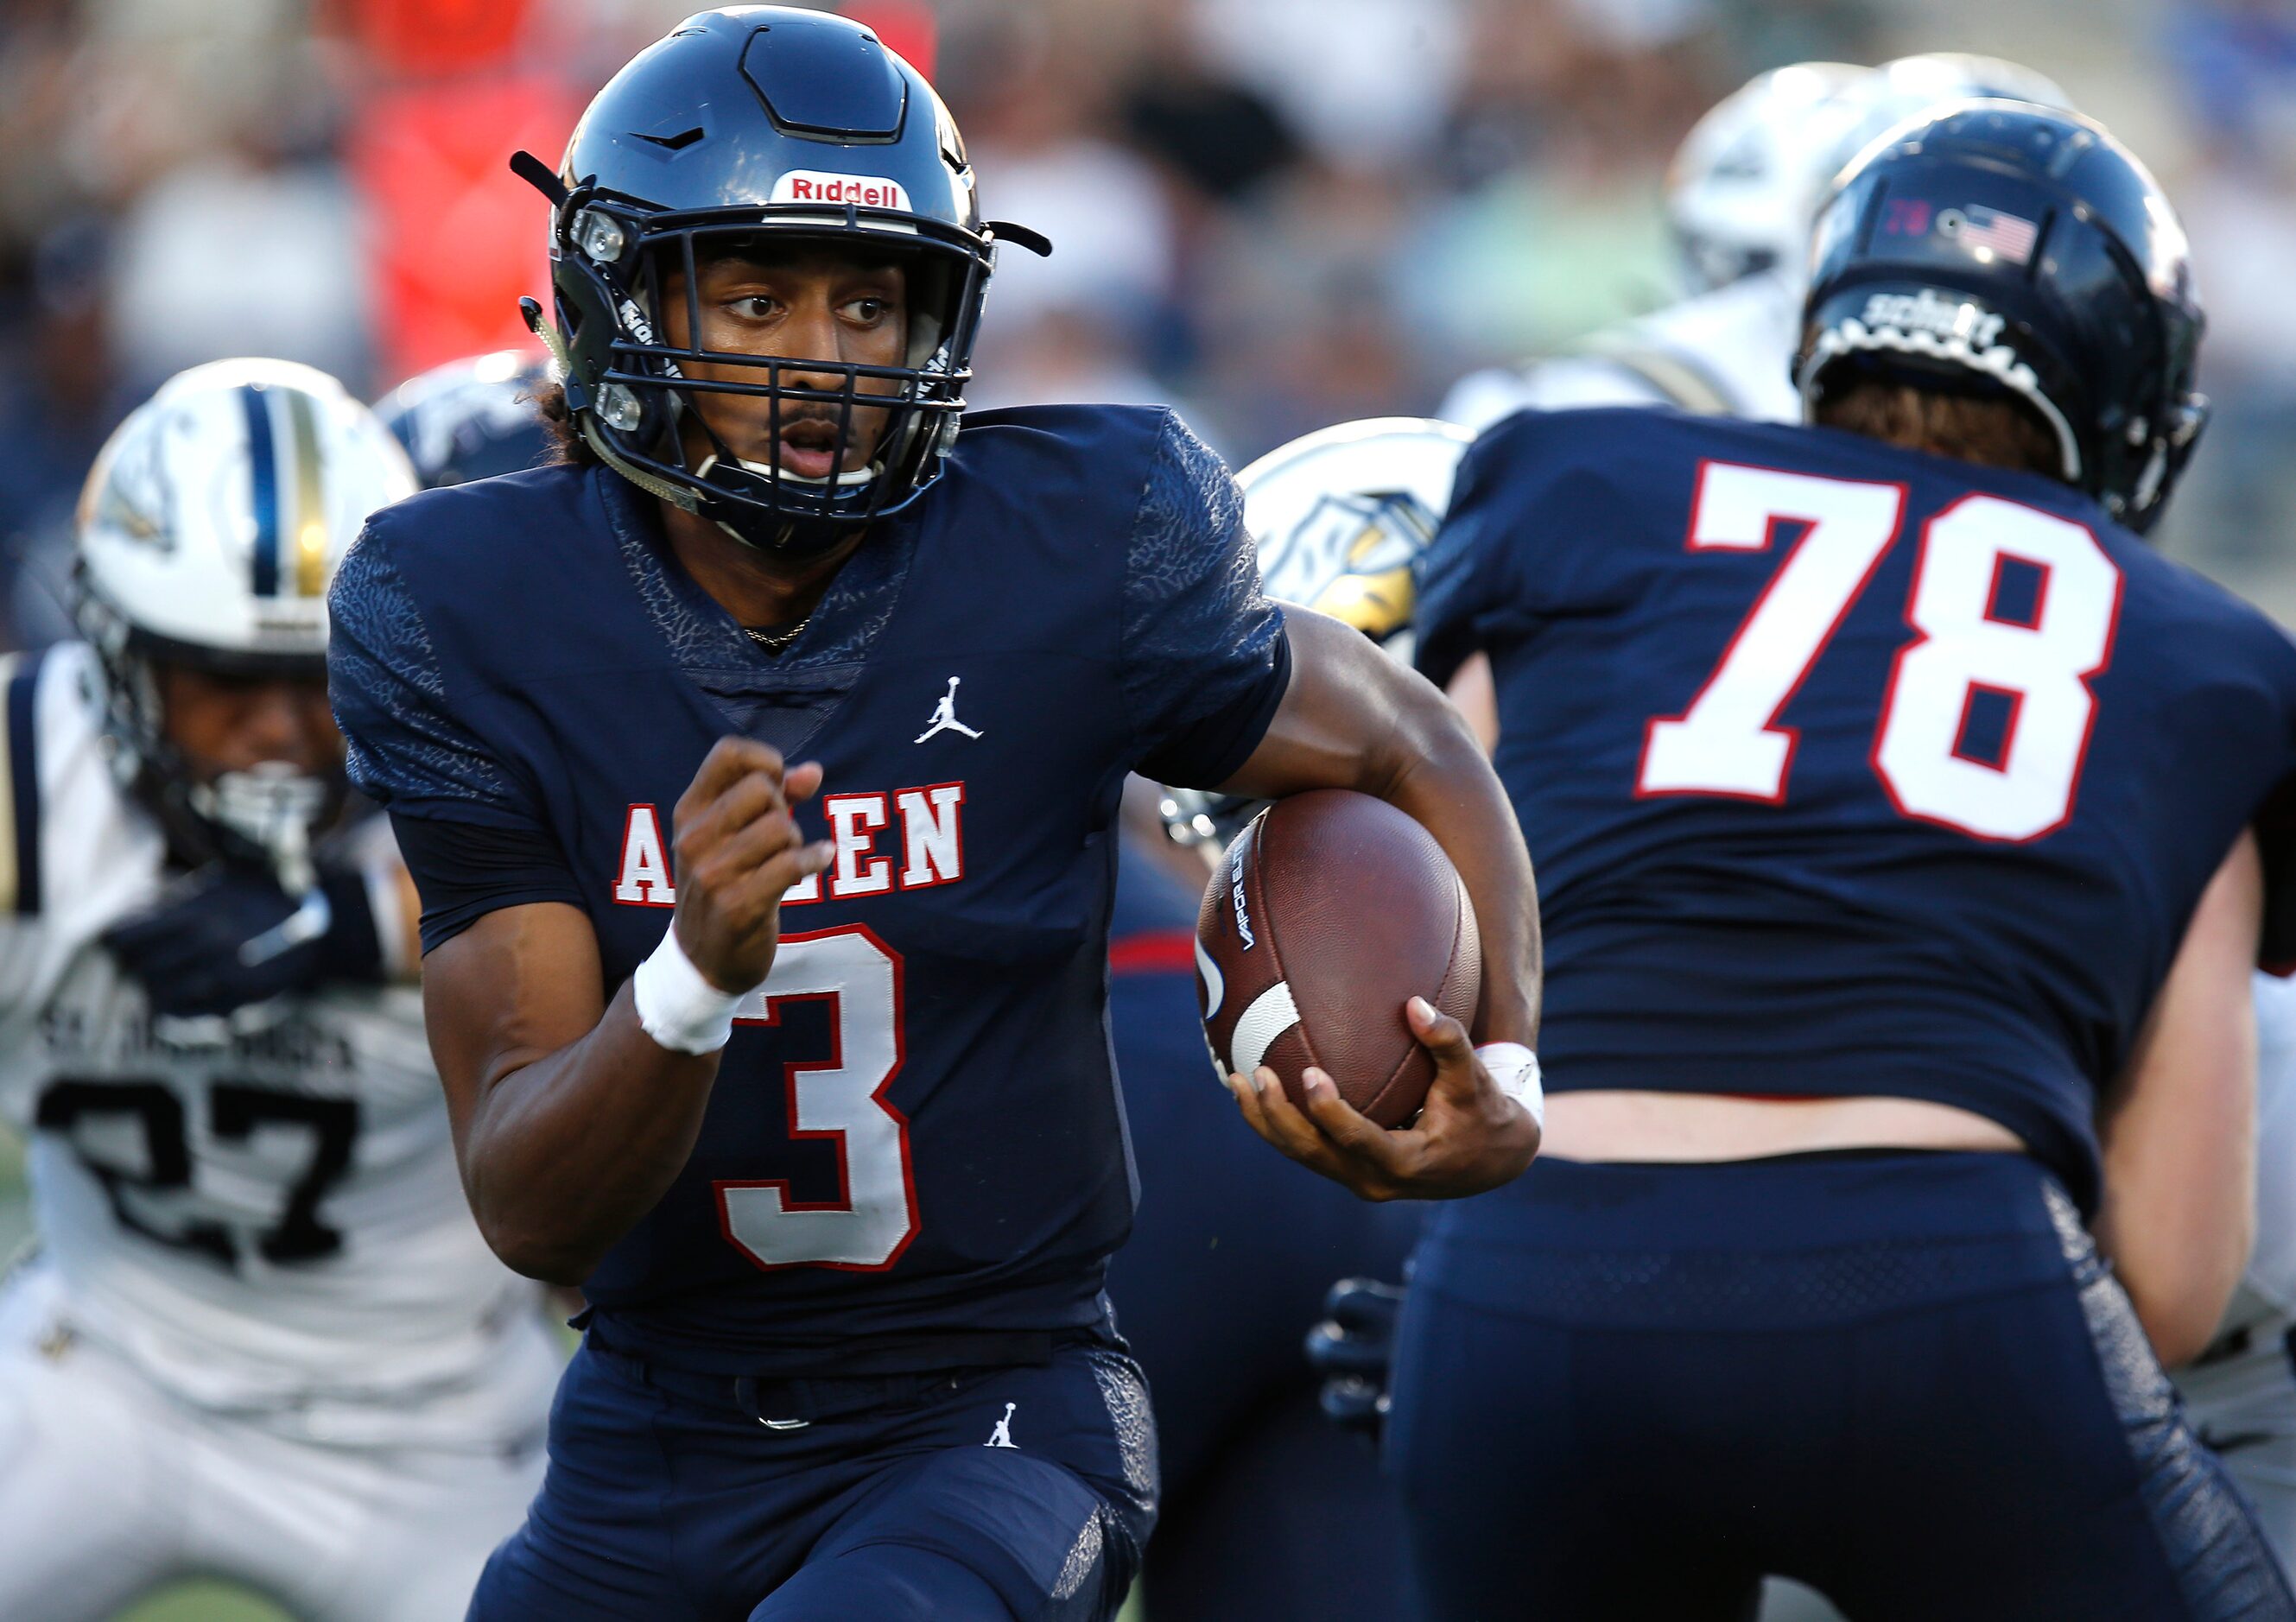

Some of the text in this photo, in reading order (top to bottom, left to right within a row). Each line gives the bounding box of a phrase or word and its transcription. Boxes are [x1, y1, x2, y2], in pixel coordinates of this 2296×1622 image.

[792, 179, 897, 208] Riddell
[1633, 458, 2125, 845] 78
[612, 781, 966, 909] AEN
[1234, 884, 1254, 951] VAPOR
[712, 922, 923, 1272] 3
